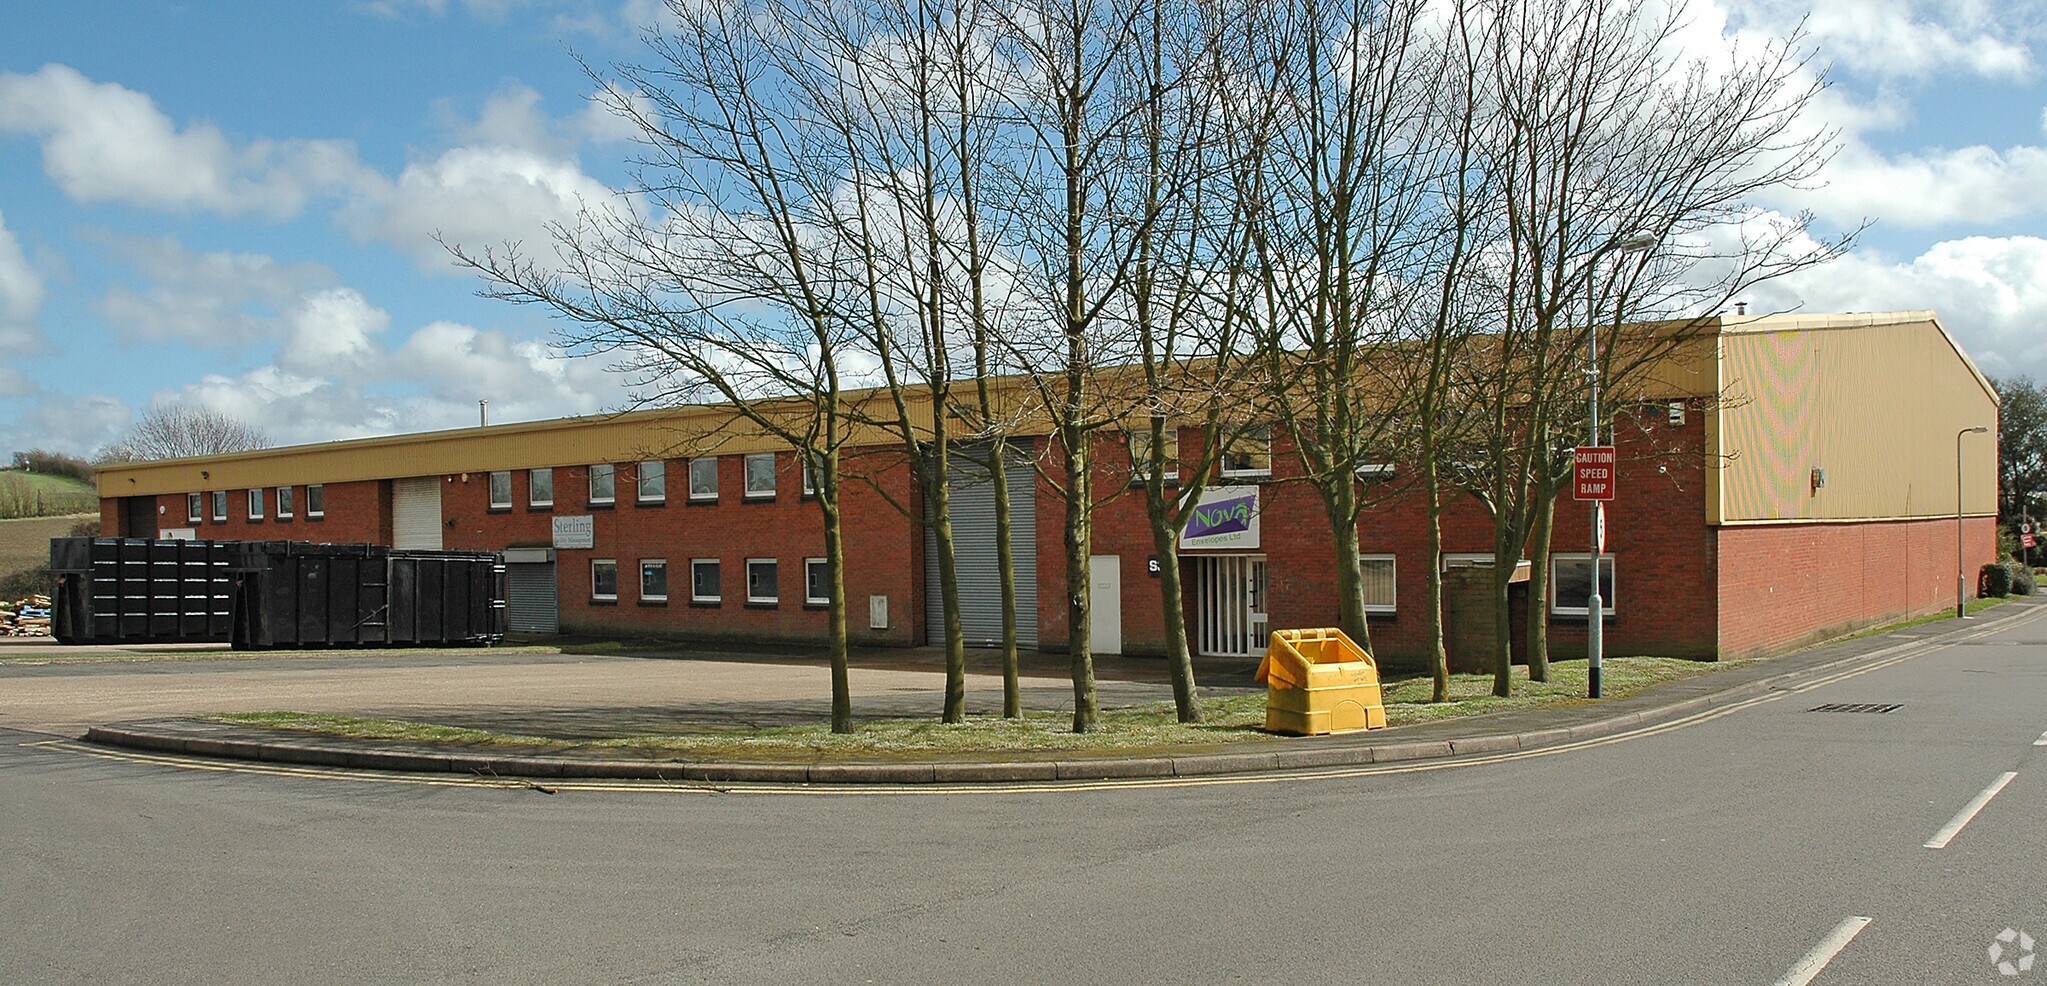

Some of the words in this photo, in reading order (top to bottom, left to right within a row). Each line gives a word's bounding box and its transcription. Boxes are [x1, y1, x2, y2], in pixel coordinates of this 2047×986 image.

[1576, 453, 1612, 463] CAUTION
[1580, 468, 1608, 479] SPEED
[1580, 483, 1606, 494] RAMP
[1195, 502, 1249, 528] Nova
[554, 518, 591, 537] Sterling
[1191, 535, 1228, 546] Envelopes
[1229, 533, 1241, 541] Ltd
[1149, 560, 1160, 571] S
